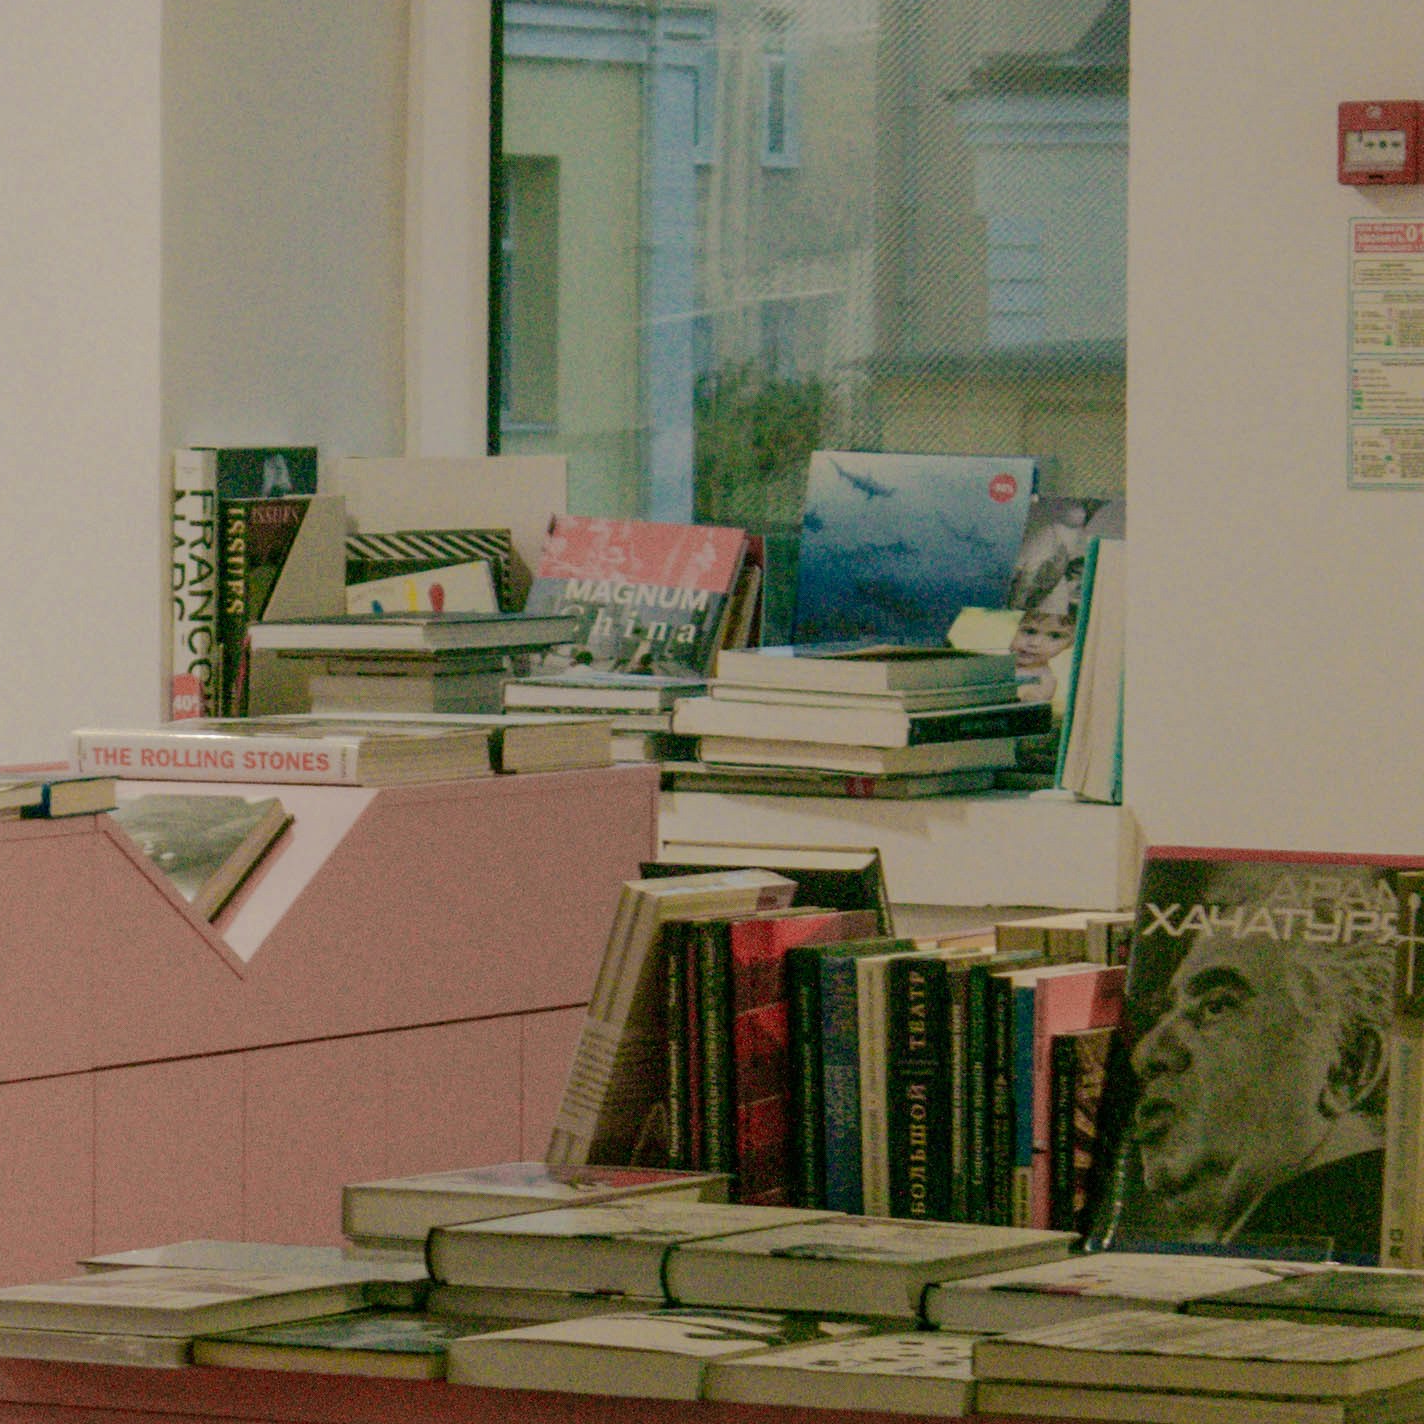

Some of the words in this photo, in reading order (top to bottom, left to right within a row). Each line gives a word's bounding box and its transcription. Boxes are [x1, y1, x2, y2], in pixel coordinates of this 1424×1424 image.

[227, 507, 245, 615] ISSUES
[564, 578, 710, 612] MAGNUM
[92, 747, 133, 767] THE
[140, 748, 236, 770] ROLLING
[243, 751, 331, 772] STONES
[908, 969, 926, 1050] ТЕАТР
[907, 1081, 927, 1215] БОЛЬШОЙ
